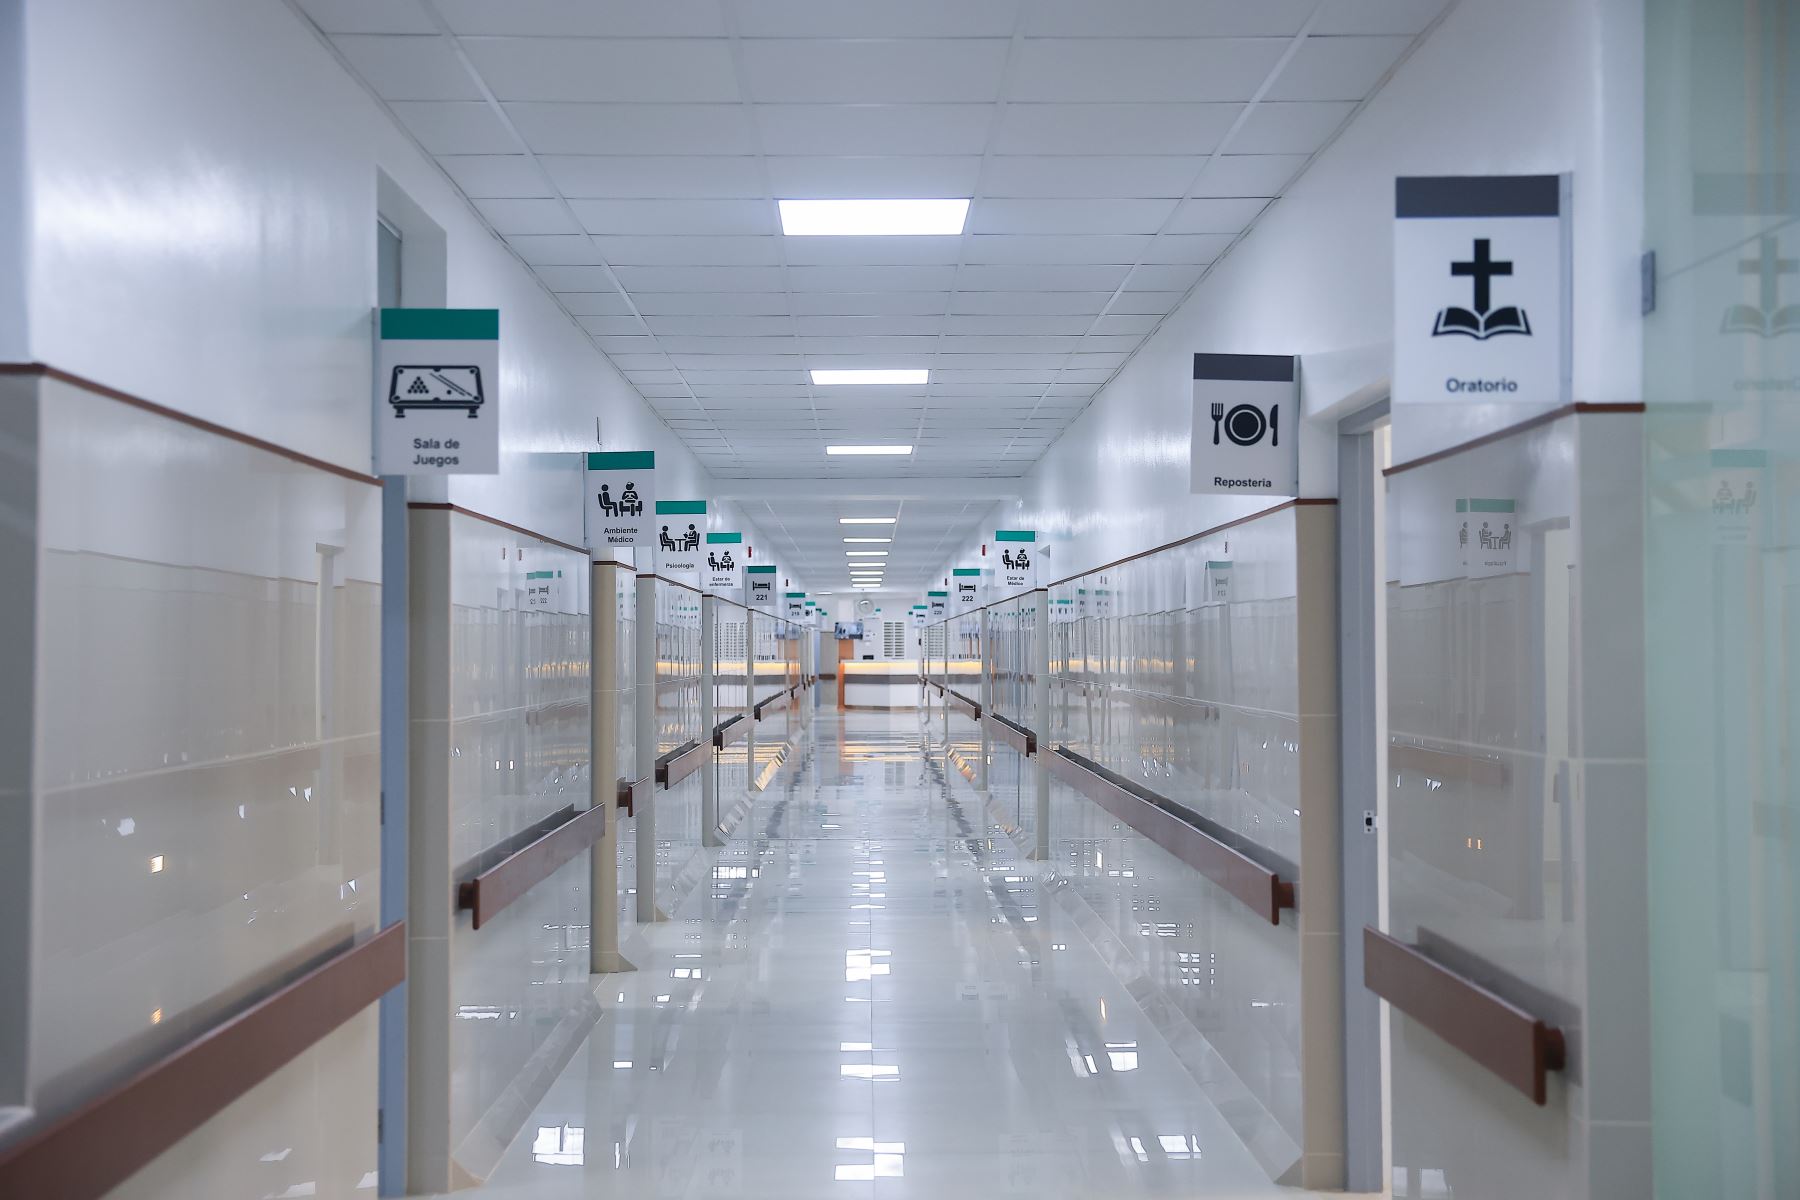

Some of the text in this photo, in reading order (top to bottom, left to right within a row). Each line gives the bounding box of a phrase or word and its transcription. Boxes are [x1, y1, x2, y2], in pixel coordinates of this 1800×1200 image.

[1446, 378, 1518, 393] Oratorio
[413, 438, 460, 449] Sala de
[413, 454, 459, 467] Juegos
[607, 535, 634, 543] Médico
